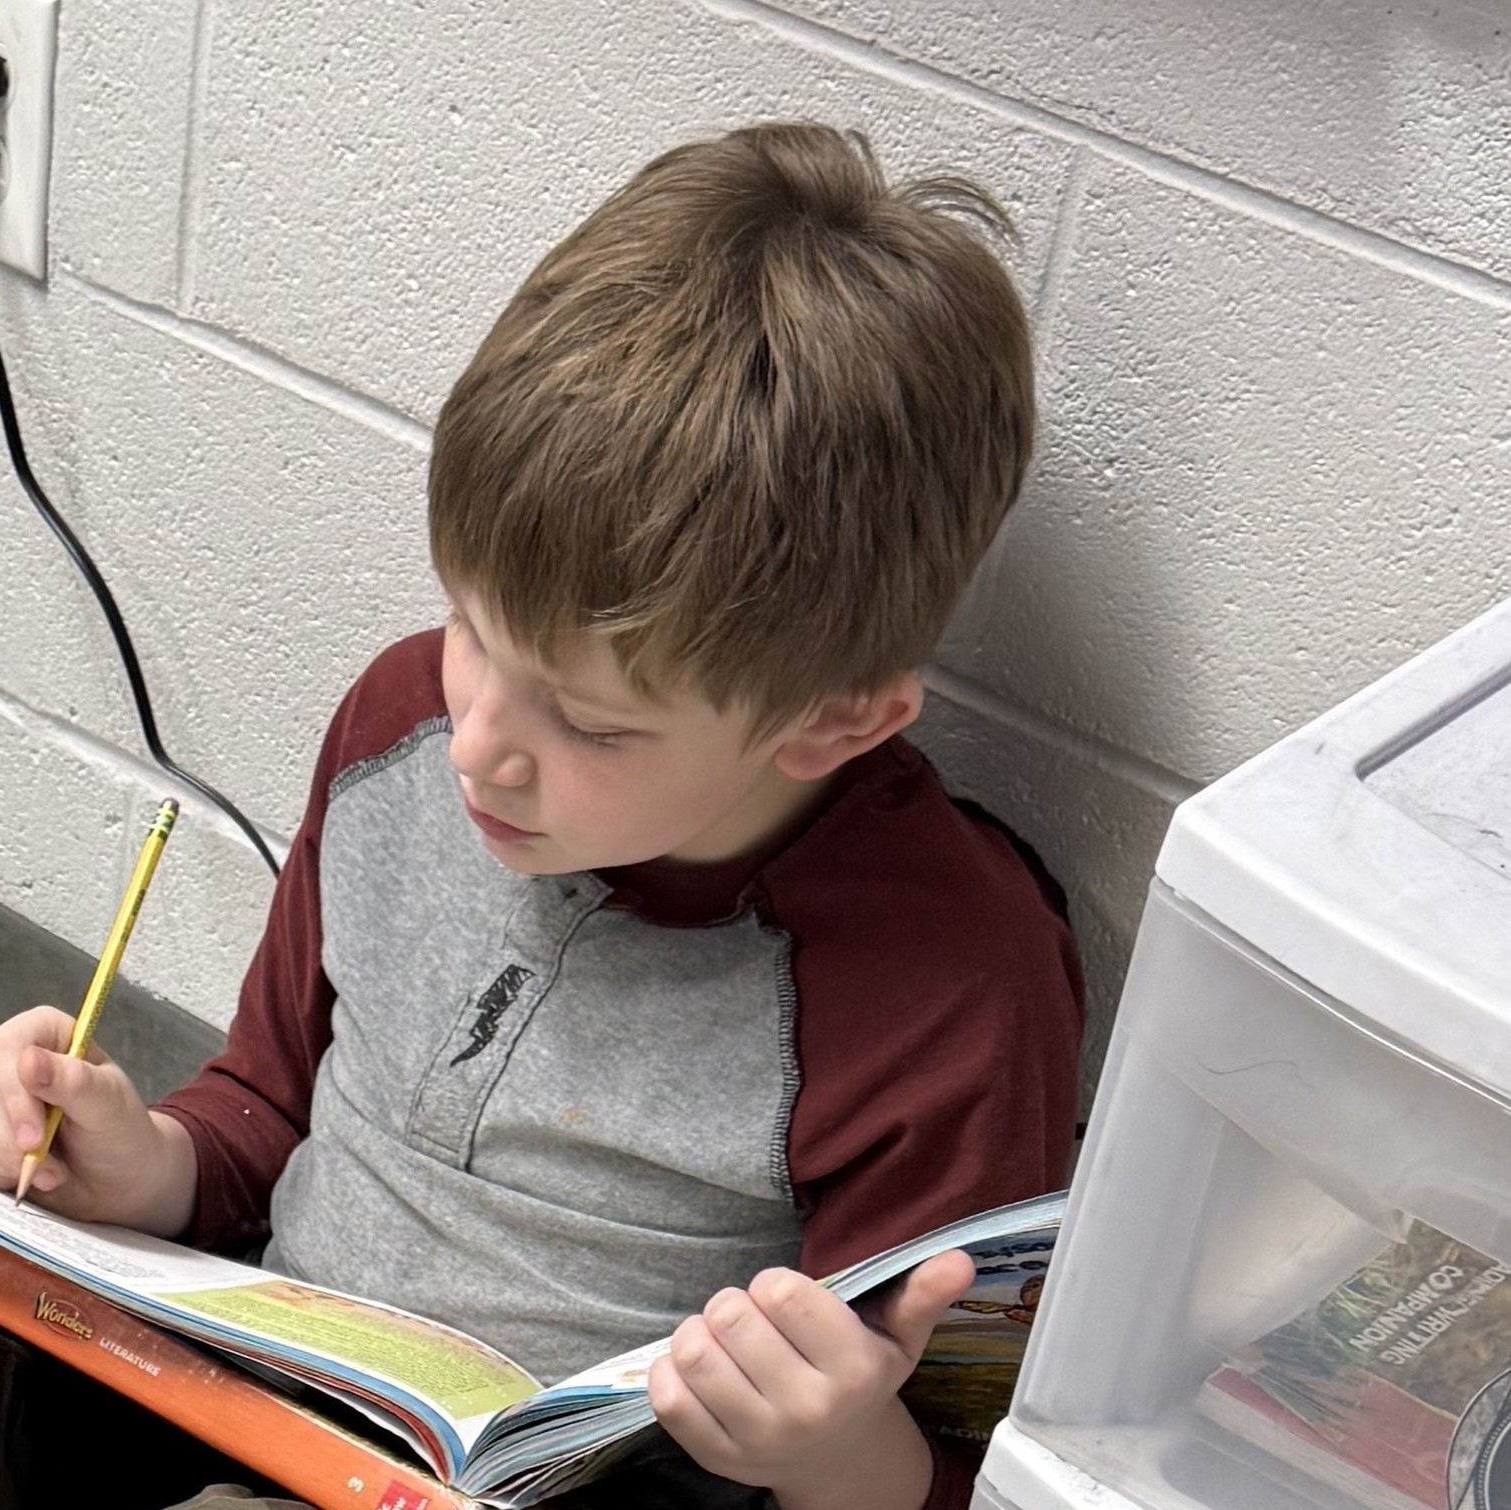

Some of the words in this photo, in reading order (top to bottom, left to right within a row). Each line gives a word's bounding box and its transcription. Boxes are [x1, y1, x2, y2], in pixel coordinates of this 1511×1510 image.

[35, 1291, 93, 1340] Wonders
[99, 1337, 162, 1377] LITERATURE
[1348, 1264, 1464, 1353] COMPANION
[347, 1476, 364, 1493] 3
